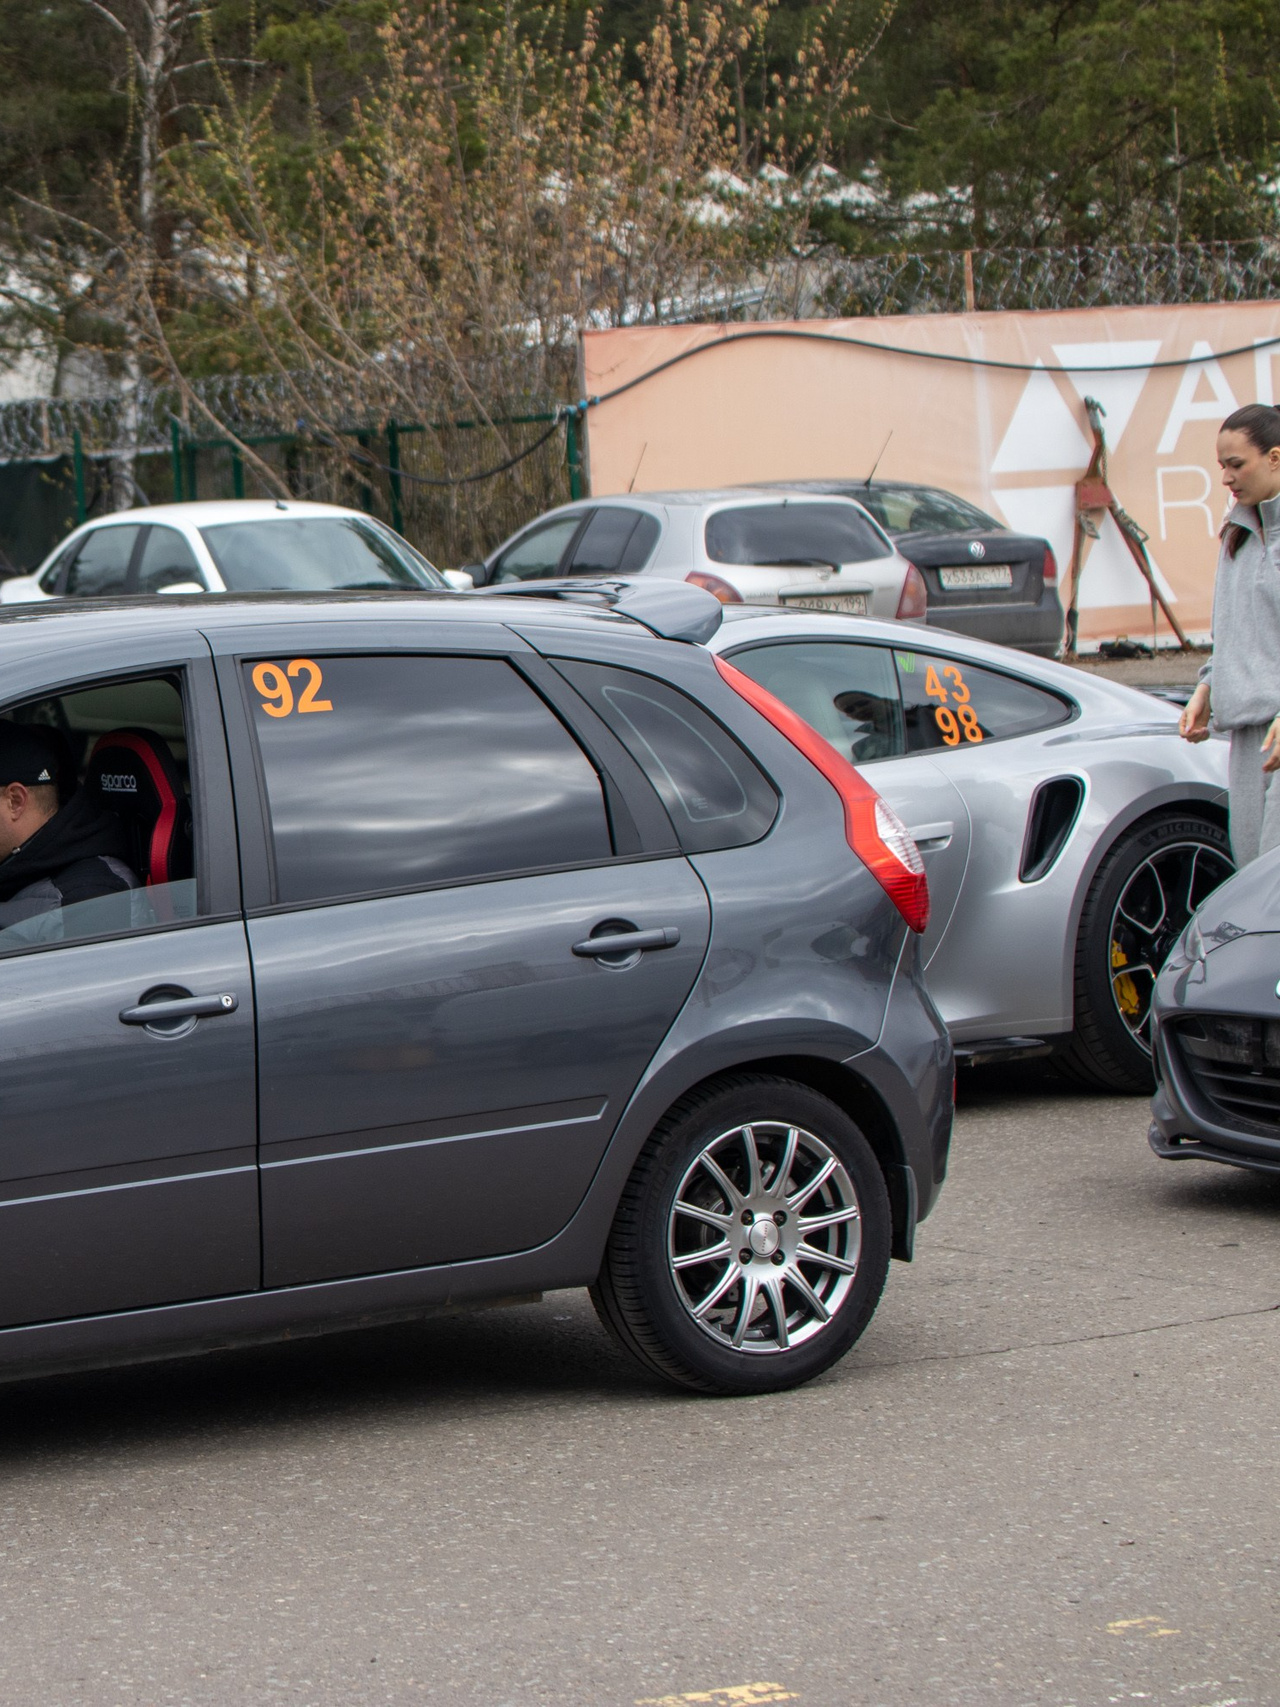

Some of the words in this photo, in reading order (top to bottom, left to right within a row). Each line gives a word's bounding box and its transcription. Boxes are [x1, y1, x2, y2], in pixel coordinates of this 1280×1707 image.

[1156, 335, 1280, 454] A
[251, 658, 334, 718] 92
[925, 664, 971, 703] 43
[935, 703, 983, 746] 98
[101, 773, 137, 792] sparco
